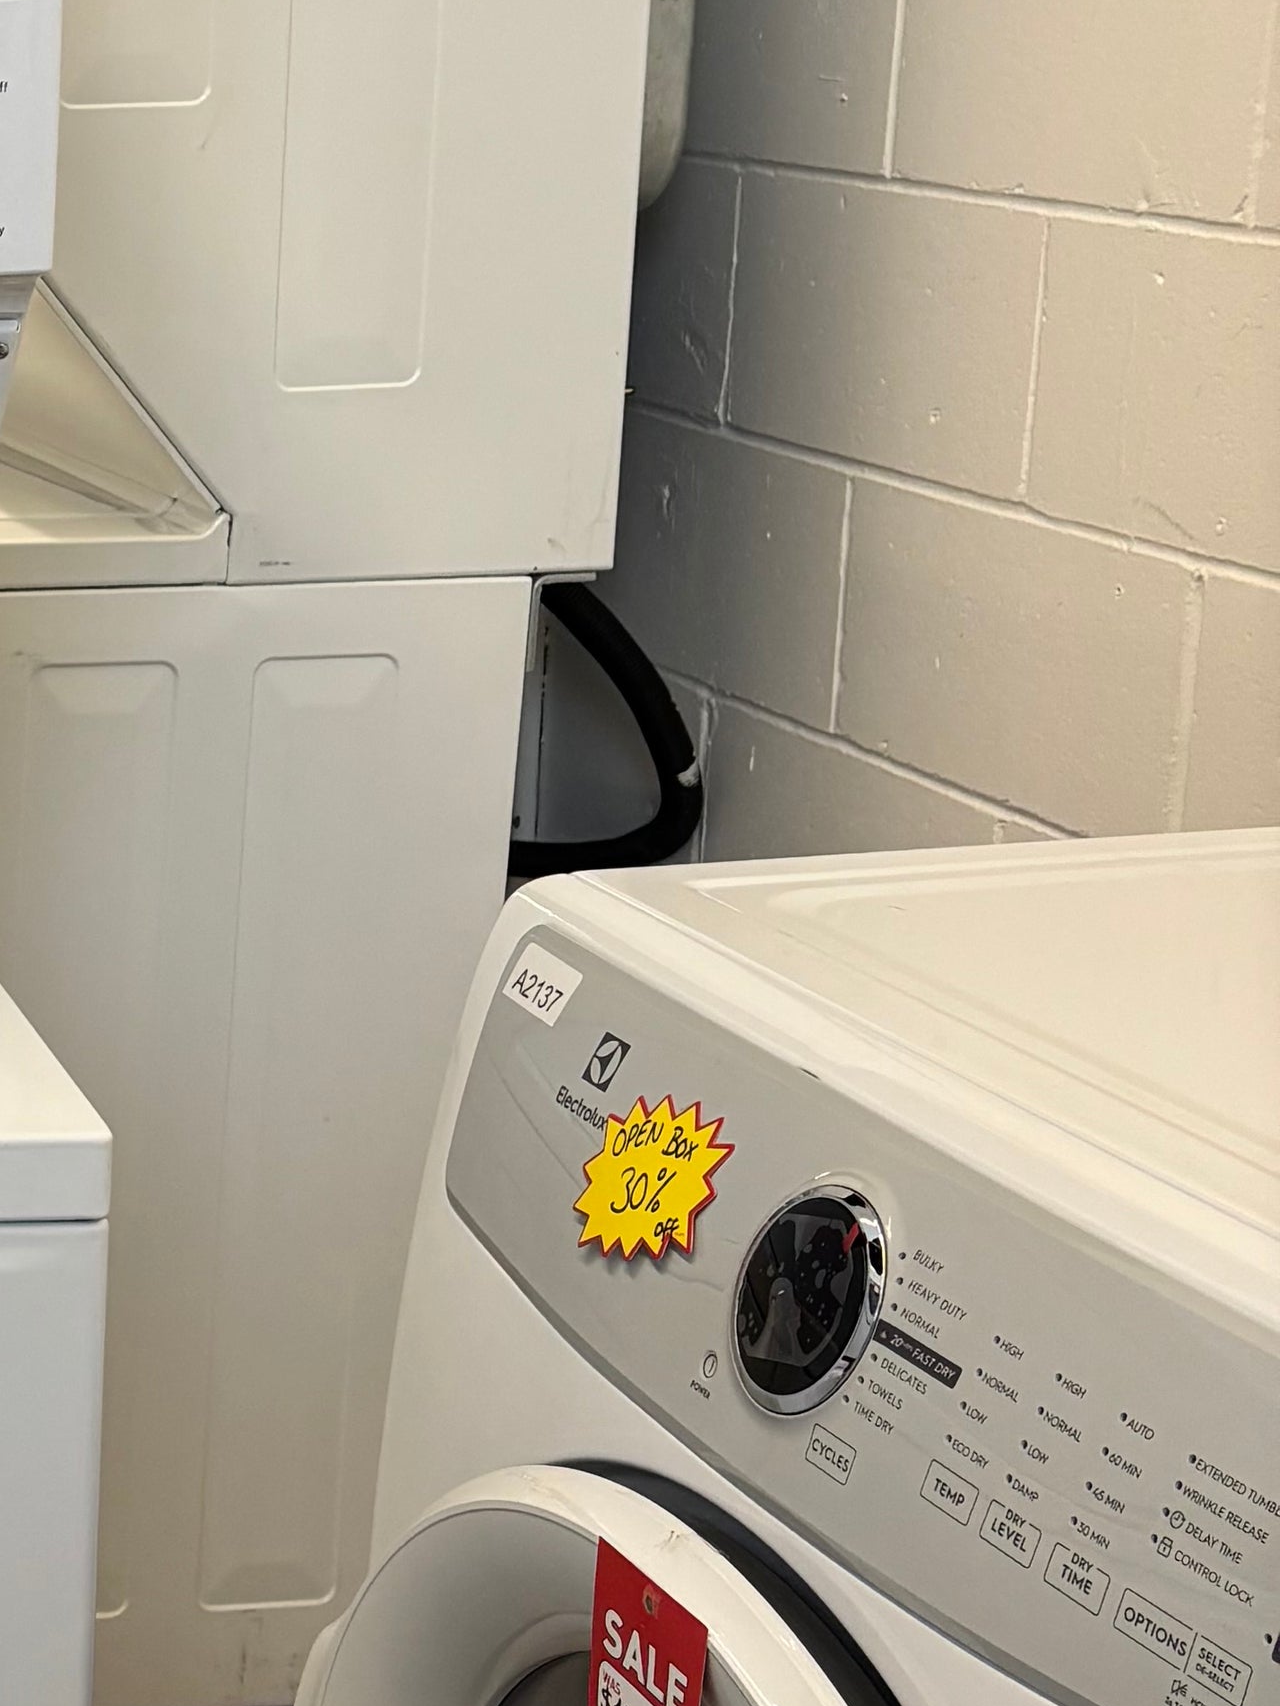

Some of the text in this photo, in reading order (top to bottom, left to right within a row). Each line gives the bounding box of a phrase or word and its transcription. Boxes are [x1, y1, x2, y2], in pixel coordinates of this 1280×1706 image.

[511, 969, 564, 1012] A2137
[556, 1085, 607, 1131] Electrolux
[612, 1119, 665, 1157] OPEN
[610, 1166, 677, 1213] 30%
[912, 1249, 945, 1274] BULKY
[908, 1280, 968, 1321] HEAVY DUTY
[899, 1308, 941, 1340] NORMAL
[912, 1349, 956, 1381] FAST DRY
[1000, 1342, 1025, 1360] HIGH
[881, 1358, 928, 1395] DELICATES
[982, 1372, 1019, 1404] NORMAL
[1062, 1380, 1087, 1399] HIGH
[868, 1380, 903, 1410] TOWELS
[854, 1401, 895, 1435] TIME DRY
[967, 1405, 989, 1425] LOW
[1043, 1411, 1084, 1443] NORMAL
[1127, 1419, 1155, 1441] AUTO
[811, 1438, 850, 1473] CYCLES
[951, 1439, 989, 1470] ECO DRY
[1027, 1444, 1049, 1465] LOW
[1108, 1453, 1143, 1479] 60 MIN
[932, 1478, 965, 1506] TEMP
[1012, 1478, 1040, 1502] DAMP
[1195, 1458, 1247, 1496] EXTENDED
[1005, 1509, 1027, 1529] DRY
[1104, 1495, 1126, 1515] MIN
[1182, 1486, 1270, 1545] WRINKLE RELEASE
[990, 1518, 1028, 1553] LEVEL
[1077, 1522, 1110, 1550] 30 MIN
[1185, 1522, 1244, 1565] DELAY TIME
[1070, 1552, 1094, 1573] DRY
[1174, 1550, 1255, 1607] CONTROL LOCK
[1060, 1564, 1094, 1595] TIME
[1124, 1607, 1187, 1657] OPTIONS
[1198, 1647, 1242, 1681] SELECT
[602, 1671, 621, 1696] WAS
